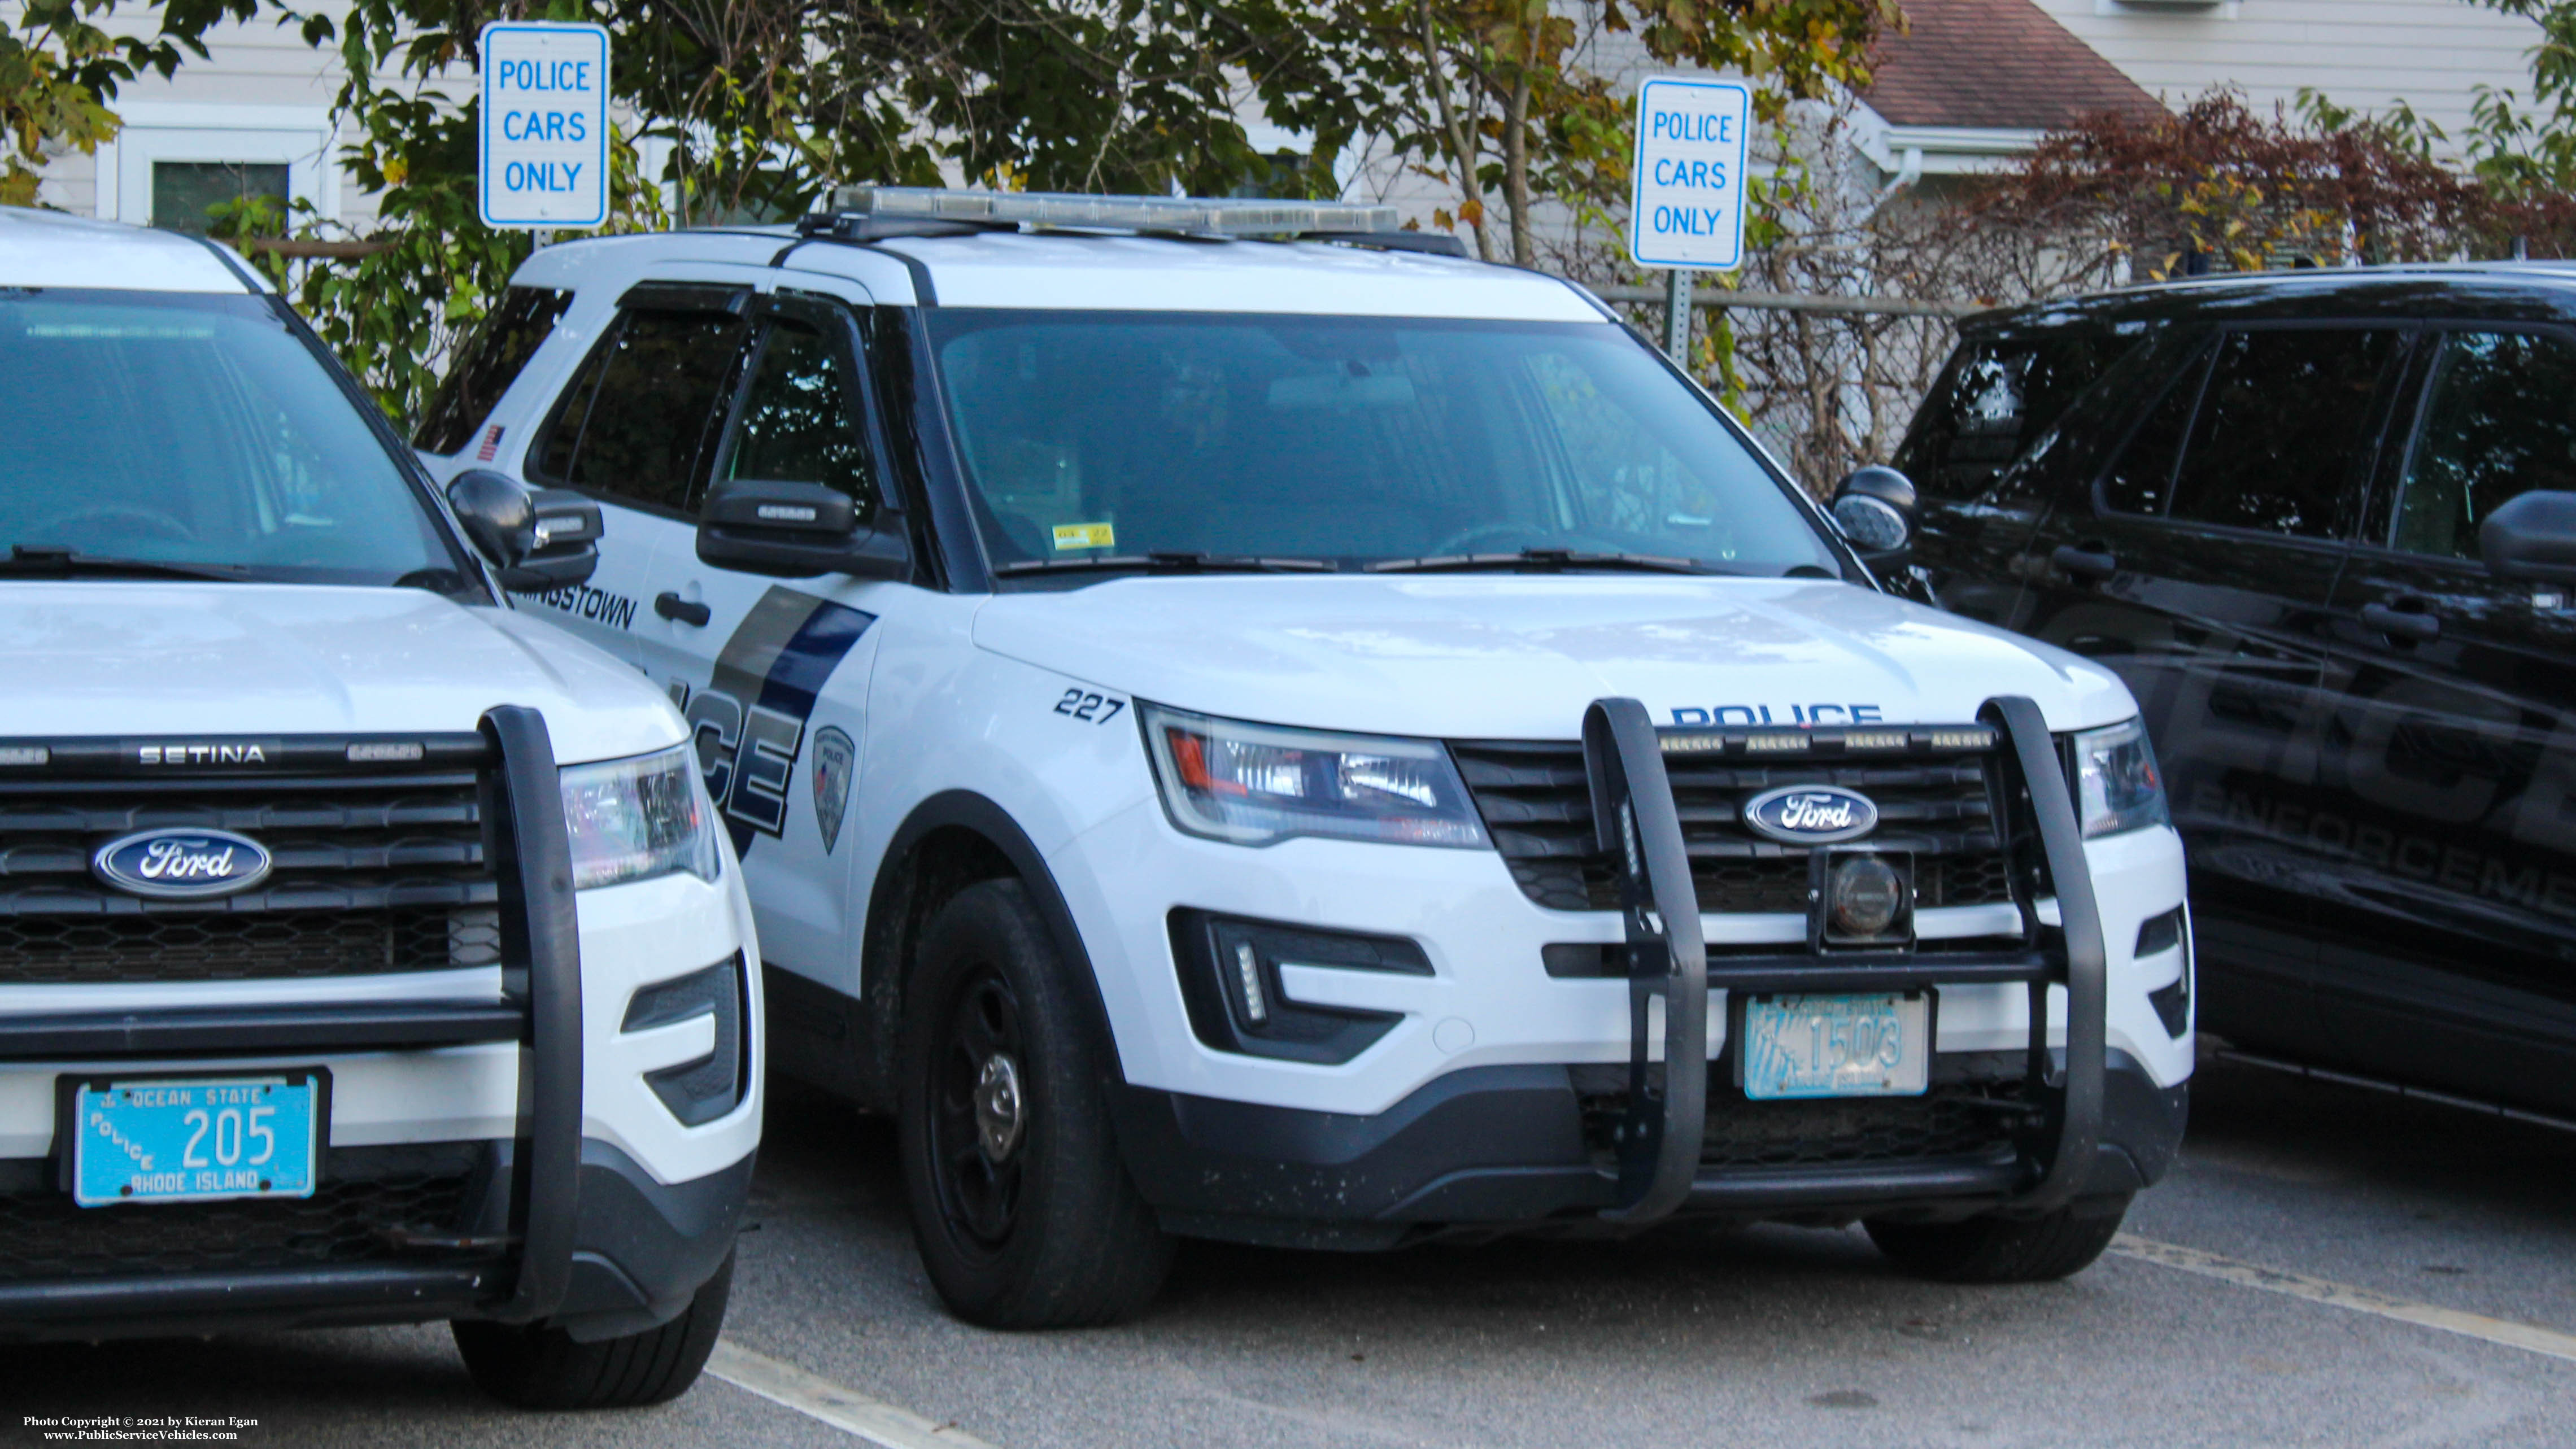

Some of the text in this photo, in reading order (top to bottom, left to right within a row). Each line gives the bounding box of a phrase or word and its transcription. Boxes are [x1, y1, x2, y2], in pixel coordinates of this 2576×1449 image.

[500, 60, 590, 91] POLICE
[504, 112, 586, 141] CARS
[1654, 112, 1732, 142] POLICE
[505, 162, 582, 192] ONLY
[1655, 159, 1726, 189] CARS
[1654, 206, 1721, 235] ONLY
[1054, 688, 1125, 724] 227
[140, 745, 265, 765] SETINA
[1781, 794, 1851, 828] Ford
[140, 839, 233, 878] Ford
[1810, 1016, 1902, 1070] 1503
[132, 1087, 261, 1107] OCEAN STATE
[90, 1112, 154, 1170] POLICE
[183, 1106, 275, 1168] 205
[130, 1171, 259, 1193] RHODE ISLAND
